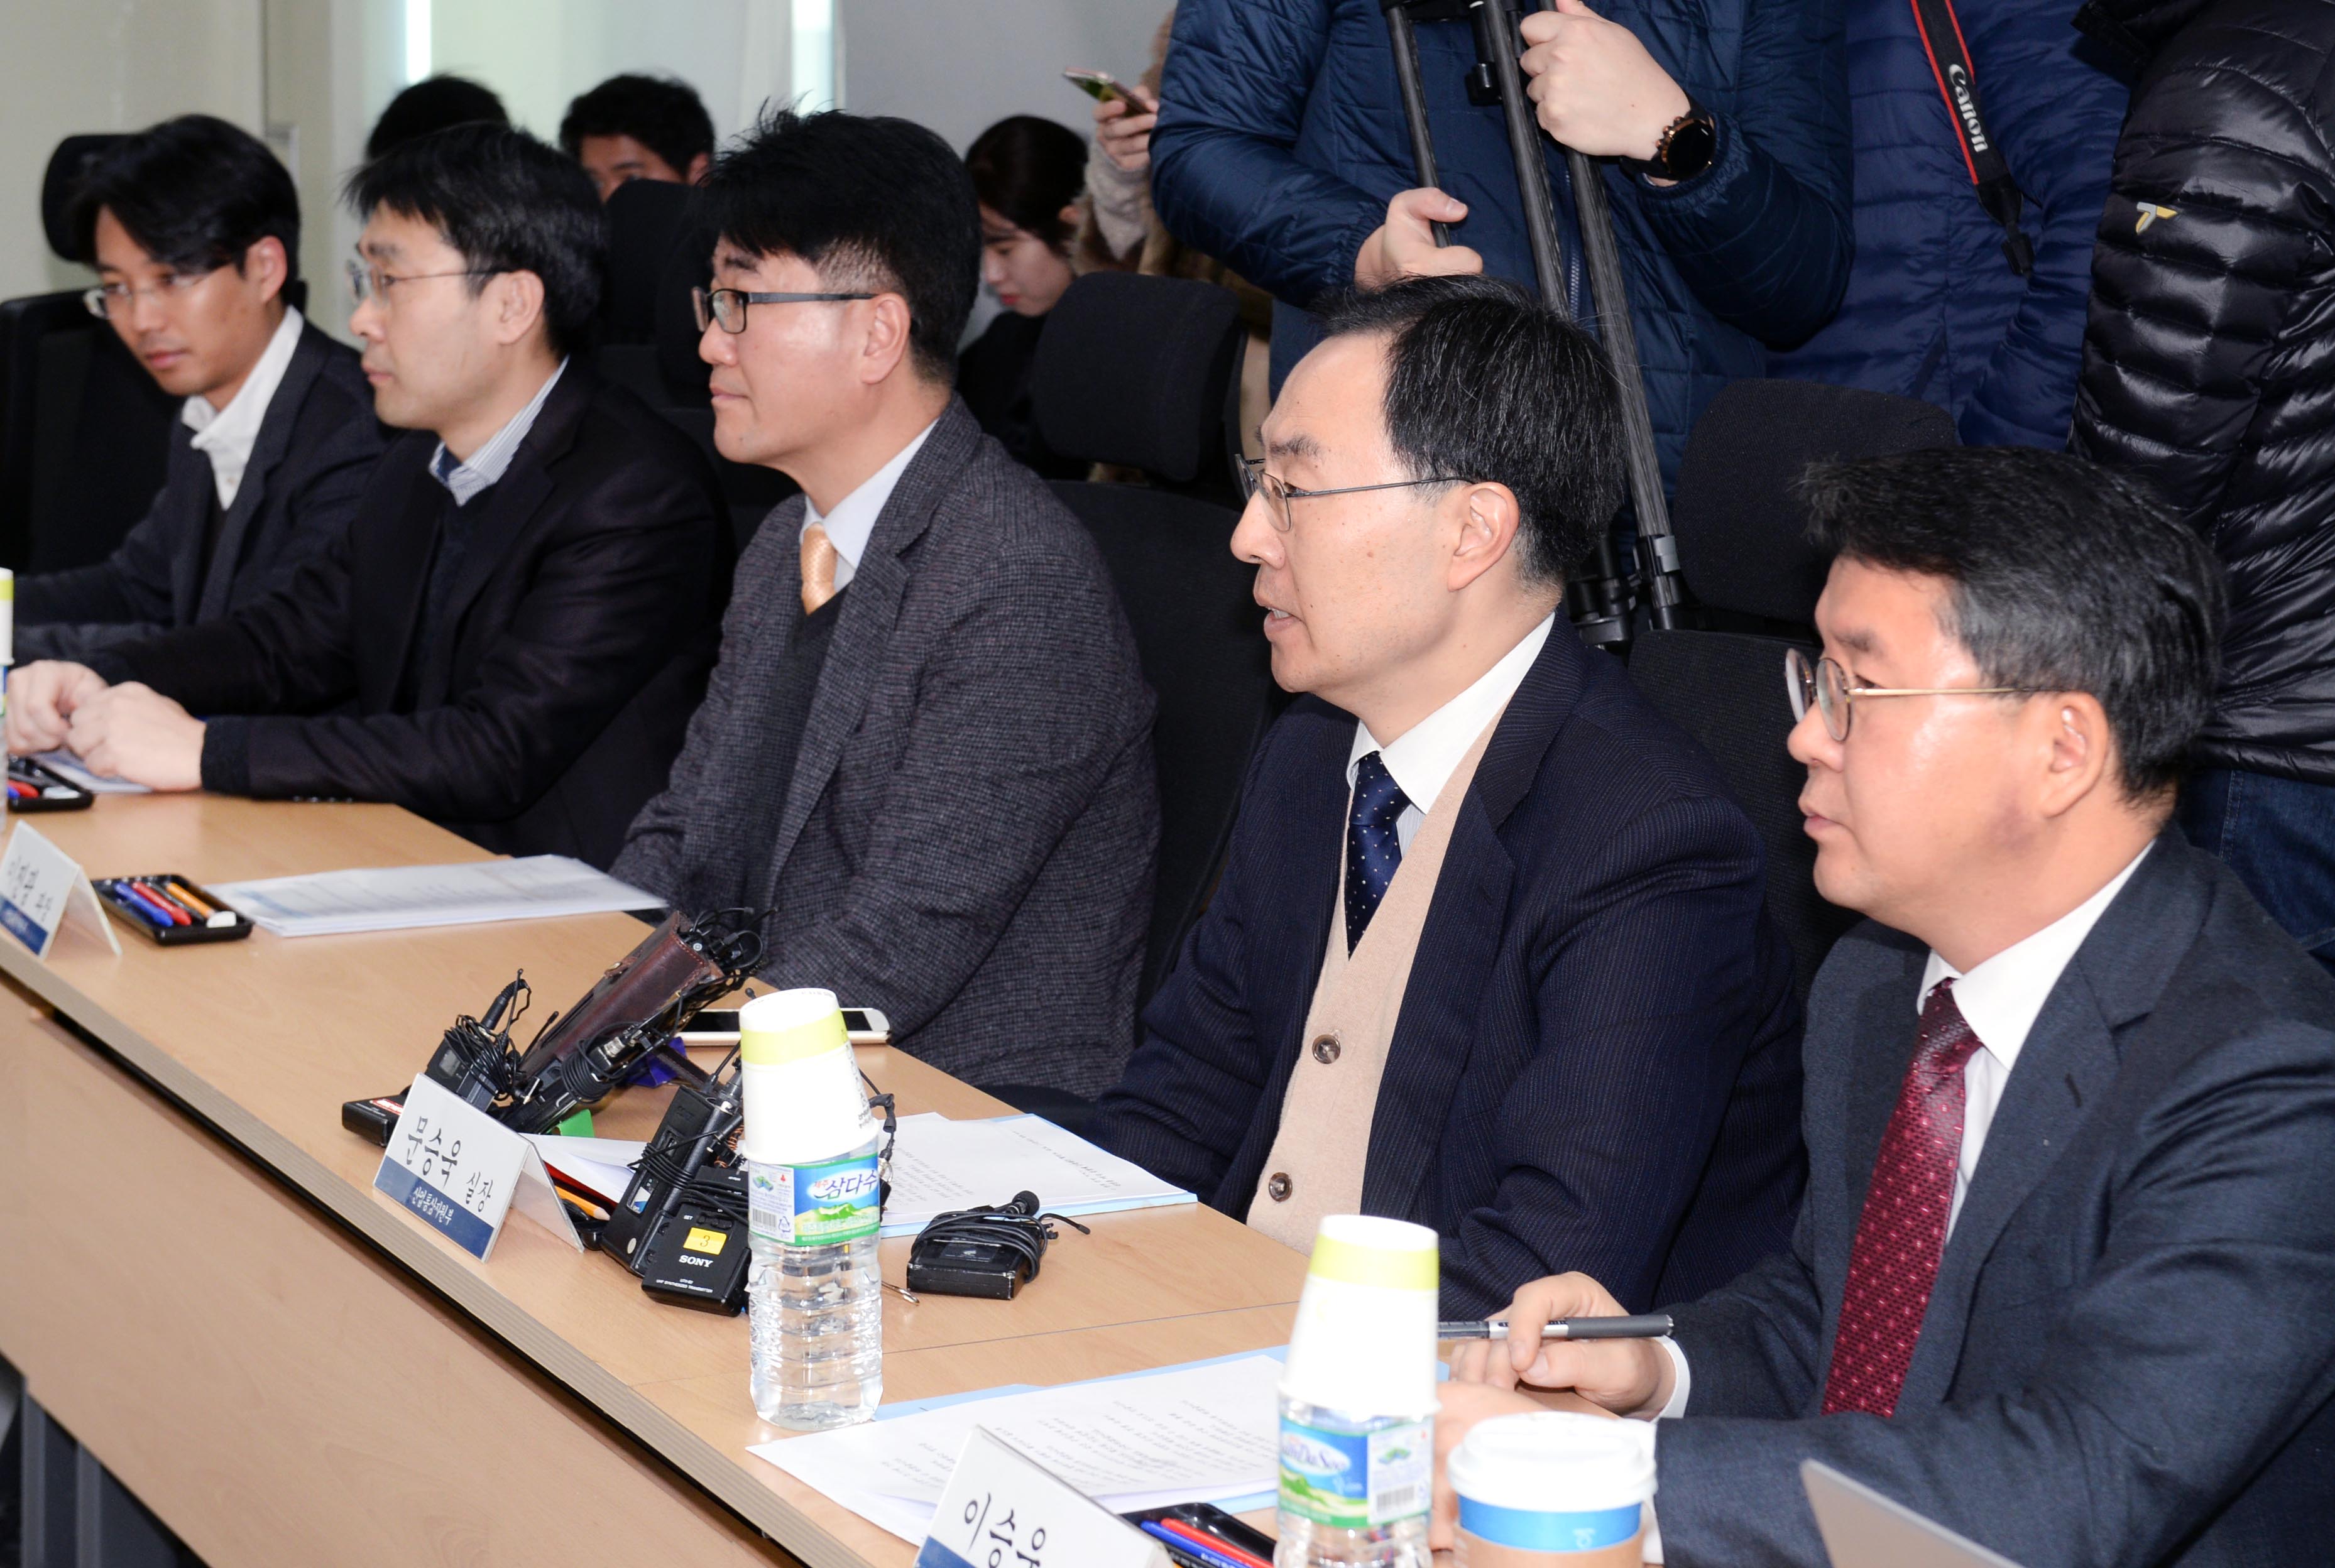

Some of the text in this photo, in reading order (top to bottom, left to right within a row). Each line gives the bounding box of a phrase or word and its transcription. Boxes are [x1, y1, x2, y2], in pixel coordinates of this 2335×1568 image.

[1949, 63, 1989, 153] Canon
[407, 1115, 493, 1213] 문승욱 실장
[822, 1170, 877, 1200] 삼다수
[412, 1186, 454, 1226] 산업통상자원부
[699, 1234, 711, 1248] 3
[679, 1255, 714, 1268] SONY
